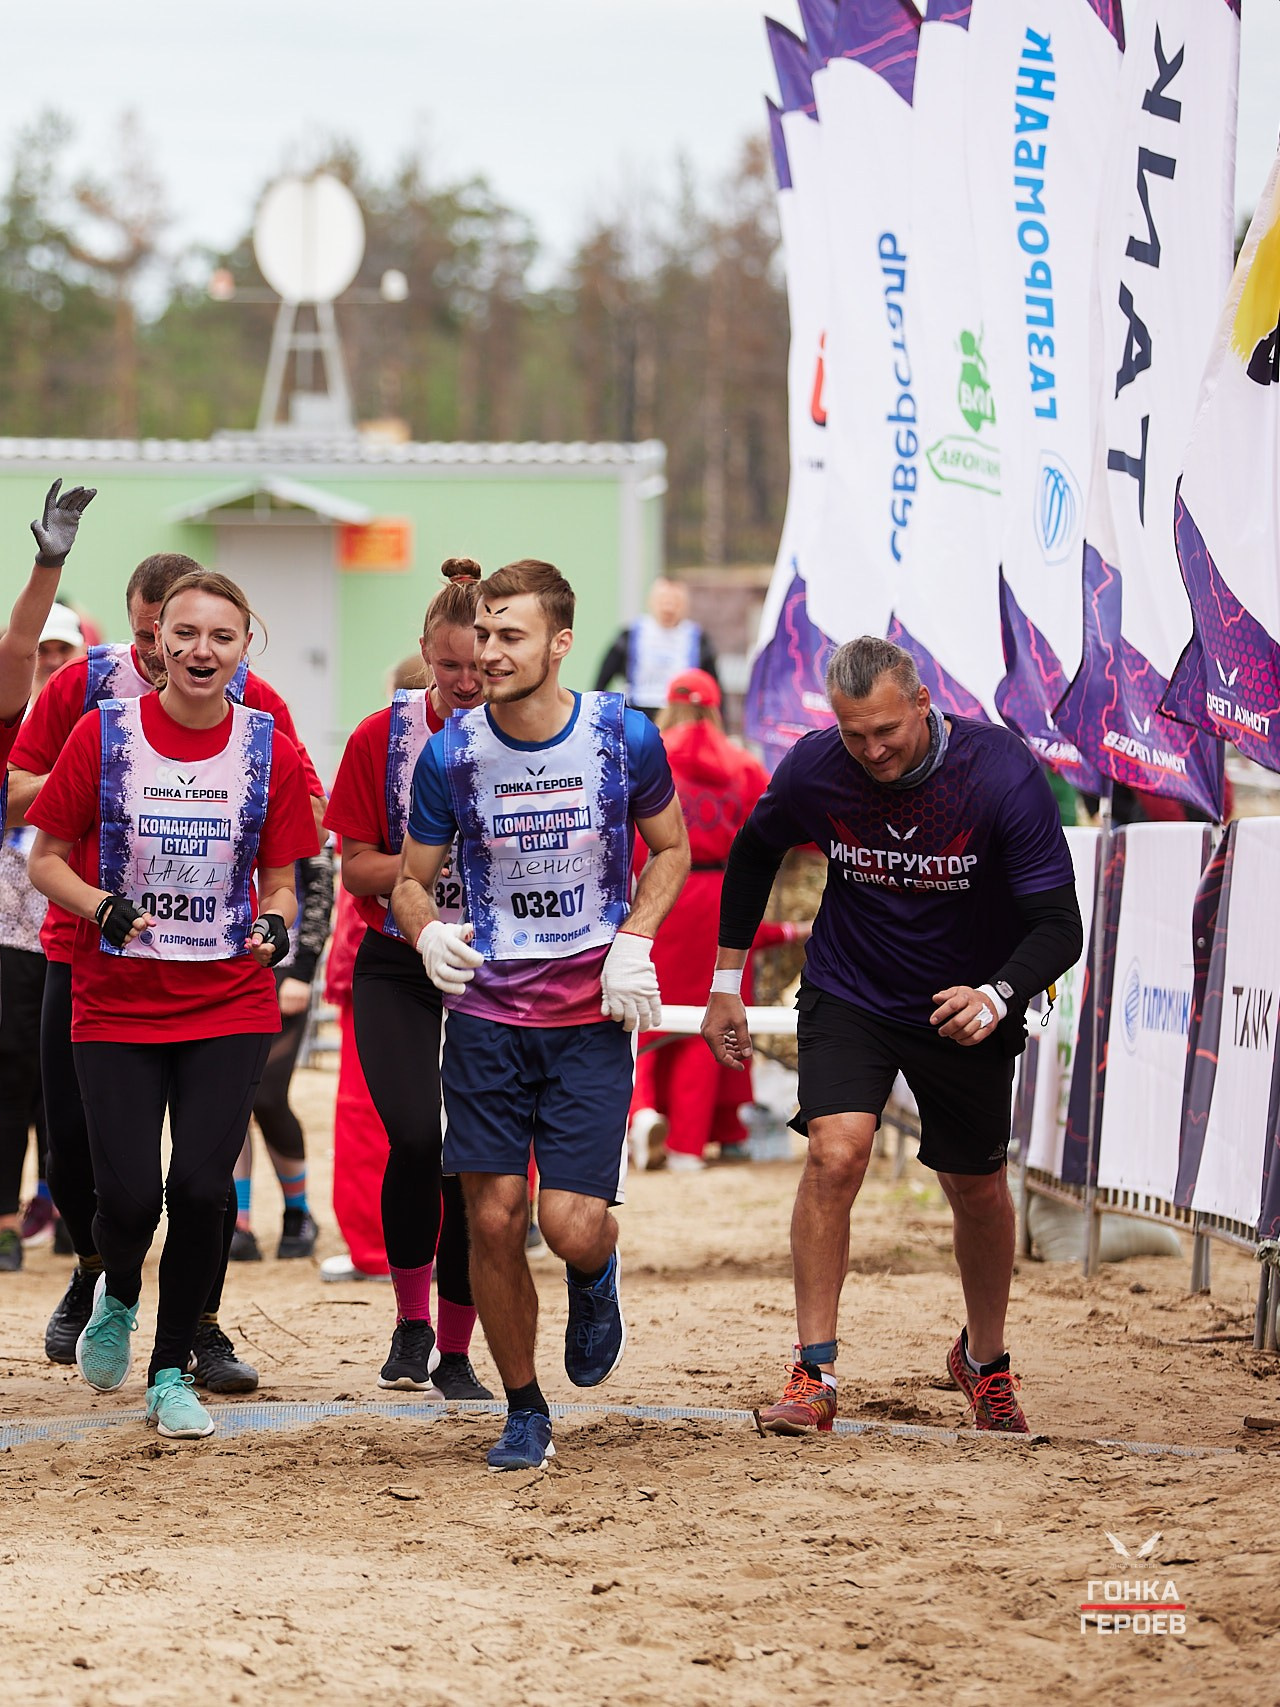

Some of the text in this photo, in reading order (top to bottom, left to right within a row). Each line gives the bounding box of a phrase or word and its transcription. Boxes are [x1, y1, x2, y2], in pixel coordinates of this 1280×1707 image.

[144, 786, 228, 799] ГОНКА ГЕРОЕВ
[494, 776, 583, 795] ГОНКА ГЕРОЕВ
[140, 818, 229, 840] КОМАНДНЫЙ
[495, 805, 590, 835] КОМАНДНЫЙ
[164, 838, 205, 855] СТАРТ
[521, 831, 566, 850] СТАРТ
[830, 839, 977, 875] ИНСТРУКТОР
[843, 869, 971, 891] ГОНКА ГЕРОЕВ
[141, 892, 217, 923] 03209
[511, 883, 585, 919] 03207
[159, 934, 217, 948] ГАЗПРОМБАНК
[534, 924, 591, 943] ГАЗПРОМБАНК
[1232, 985, 1273, 1052] TANK
